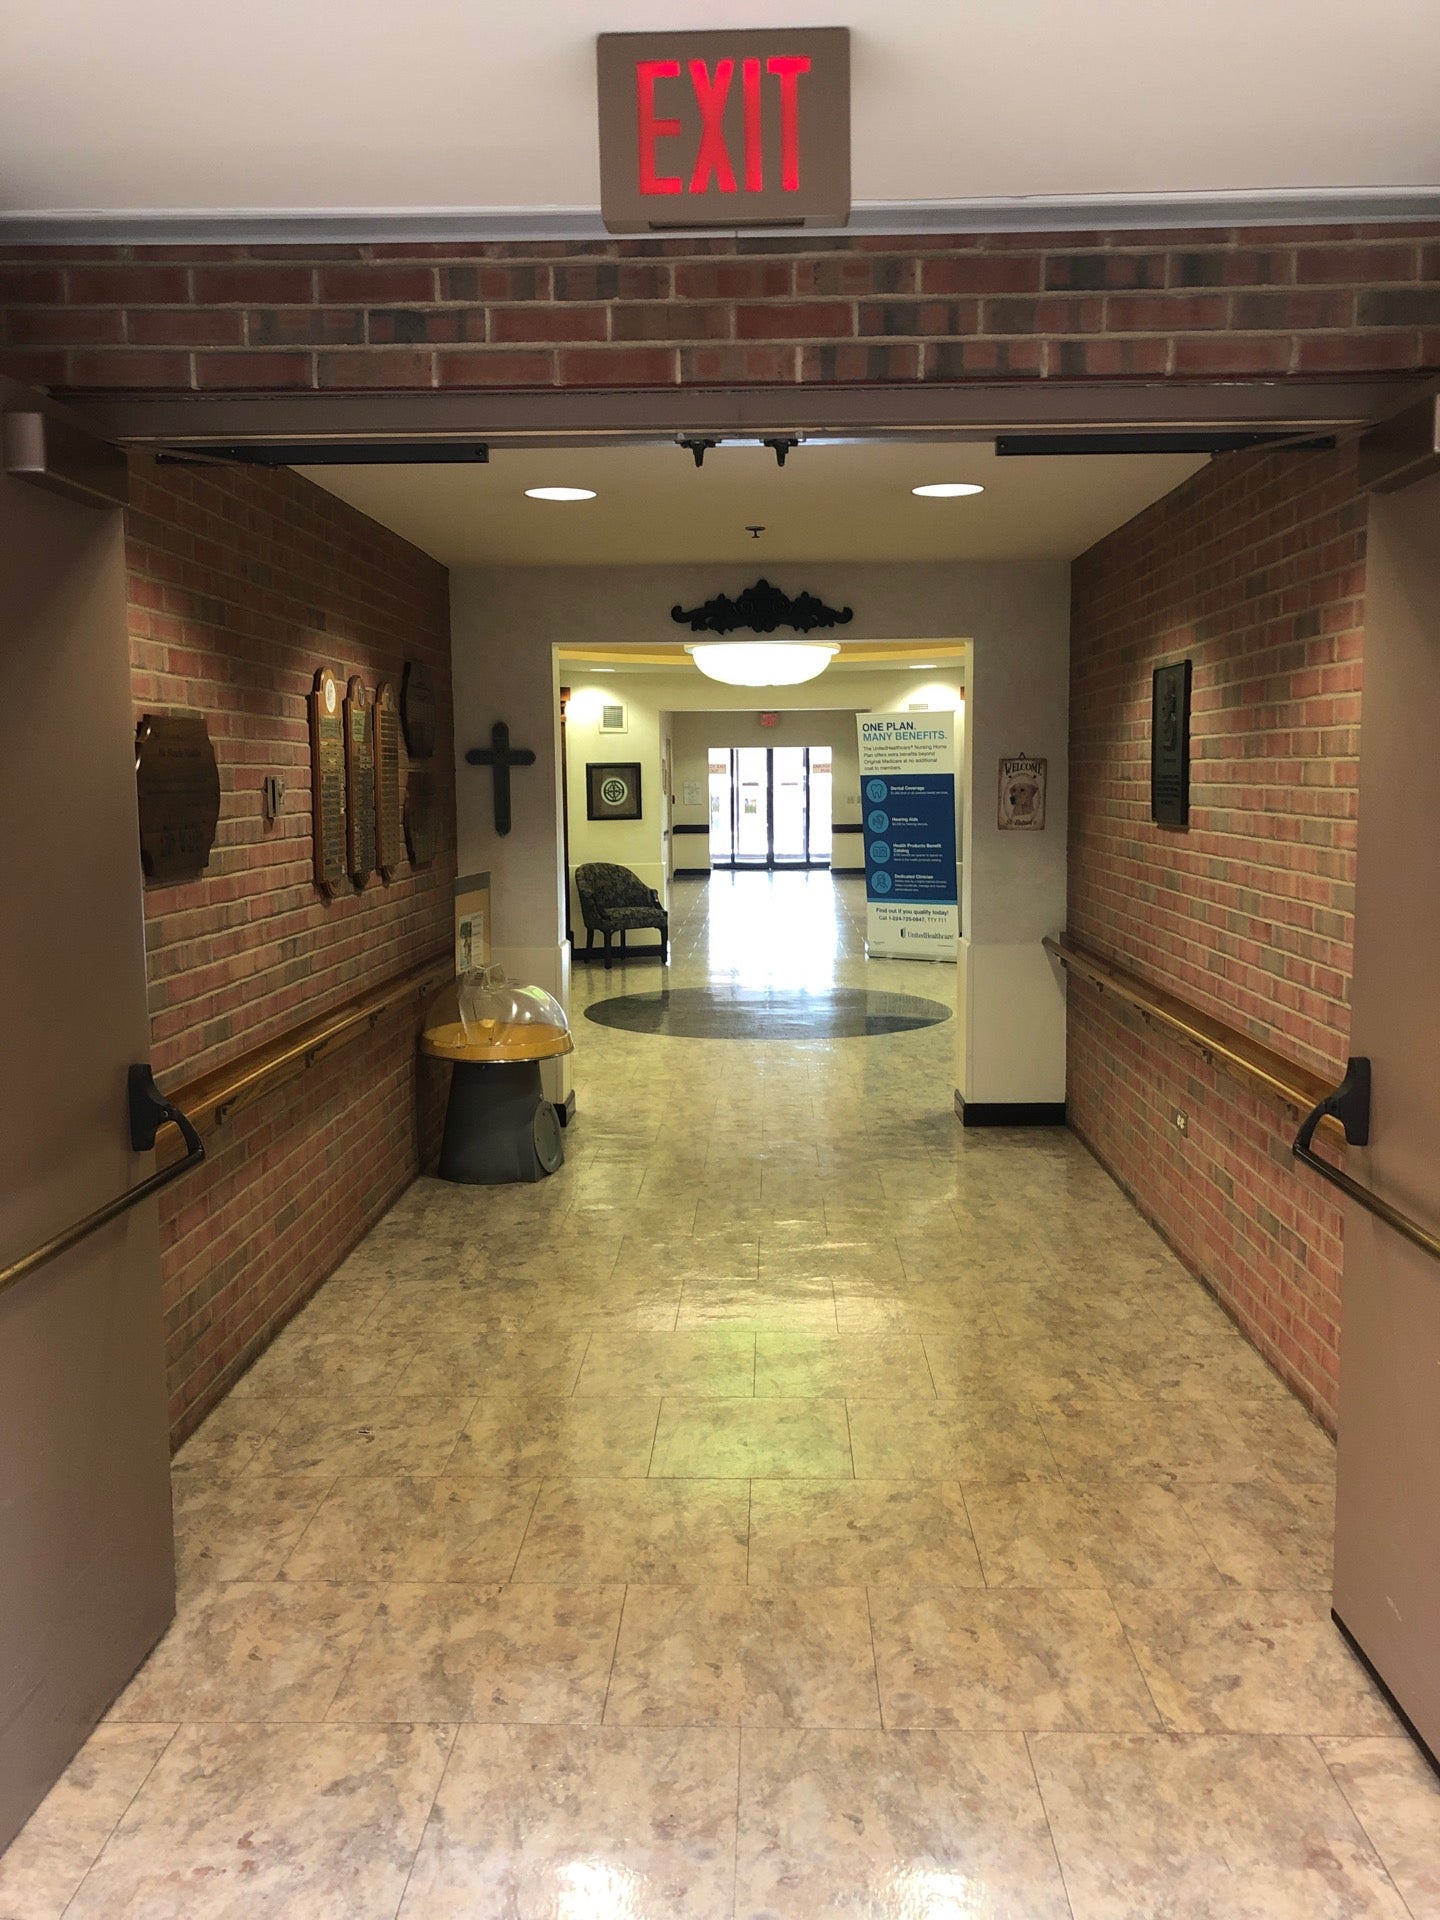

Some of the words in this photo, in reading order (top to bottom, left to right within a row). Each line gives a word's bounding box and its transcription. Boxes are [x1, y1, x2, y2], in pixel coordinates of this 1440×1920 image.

[636, 55, 811, 195] EXIT
[862, 723, 883, 731] ONE
[887, 722, 916, 730] PLAN.
[864, 732, 892, 741] MANY
[896, 731, 947, 740] BENEFITS.
[1004, 762, 1043, 776] WELCOME
